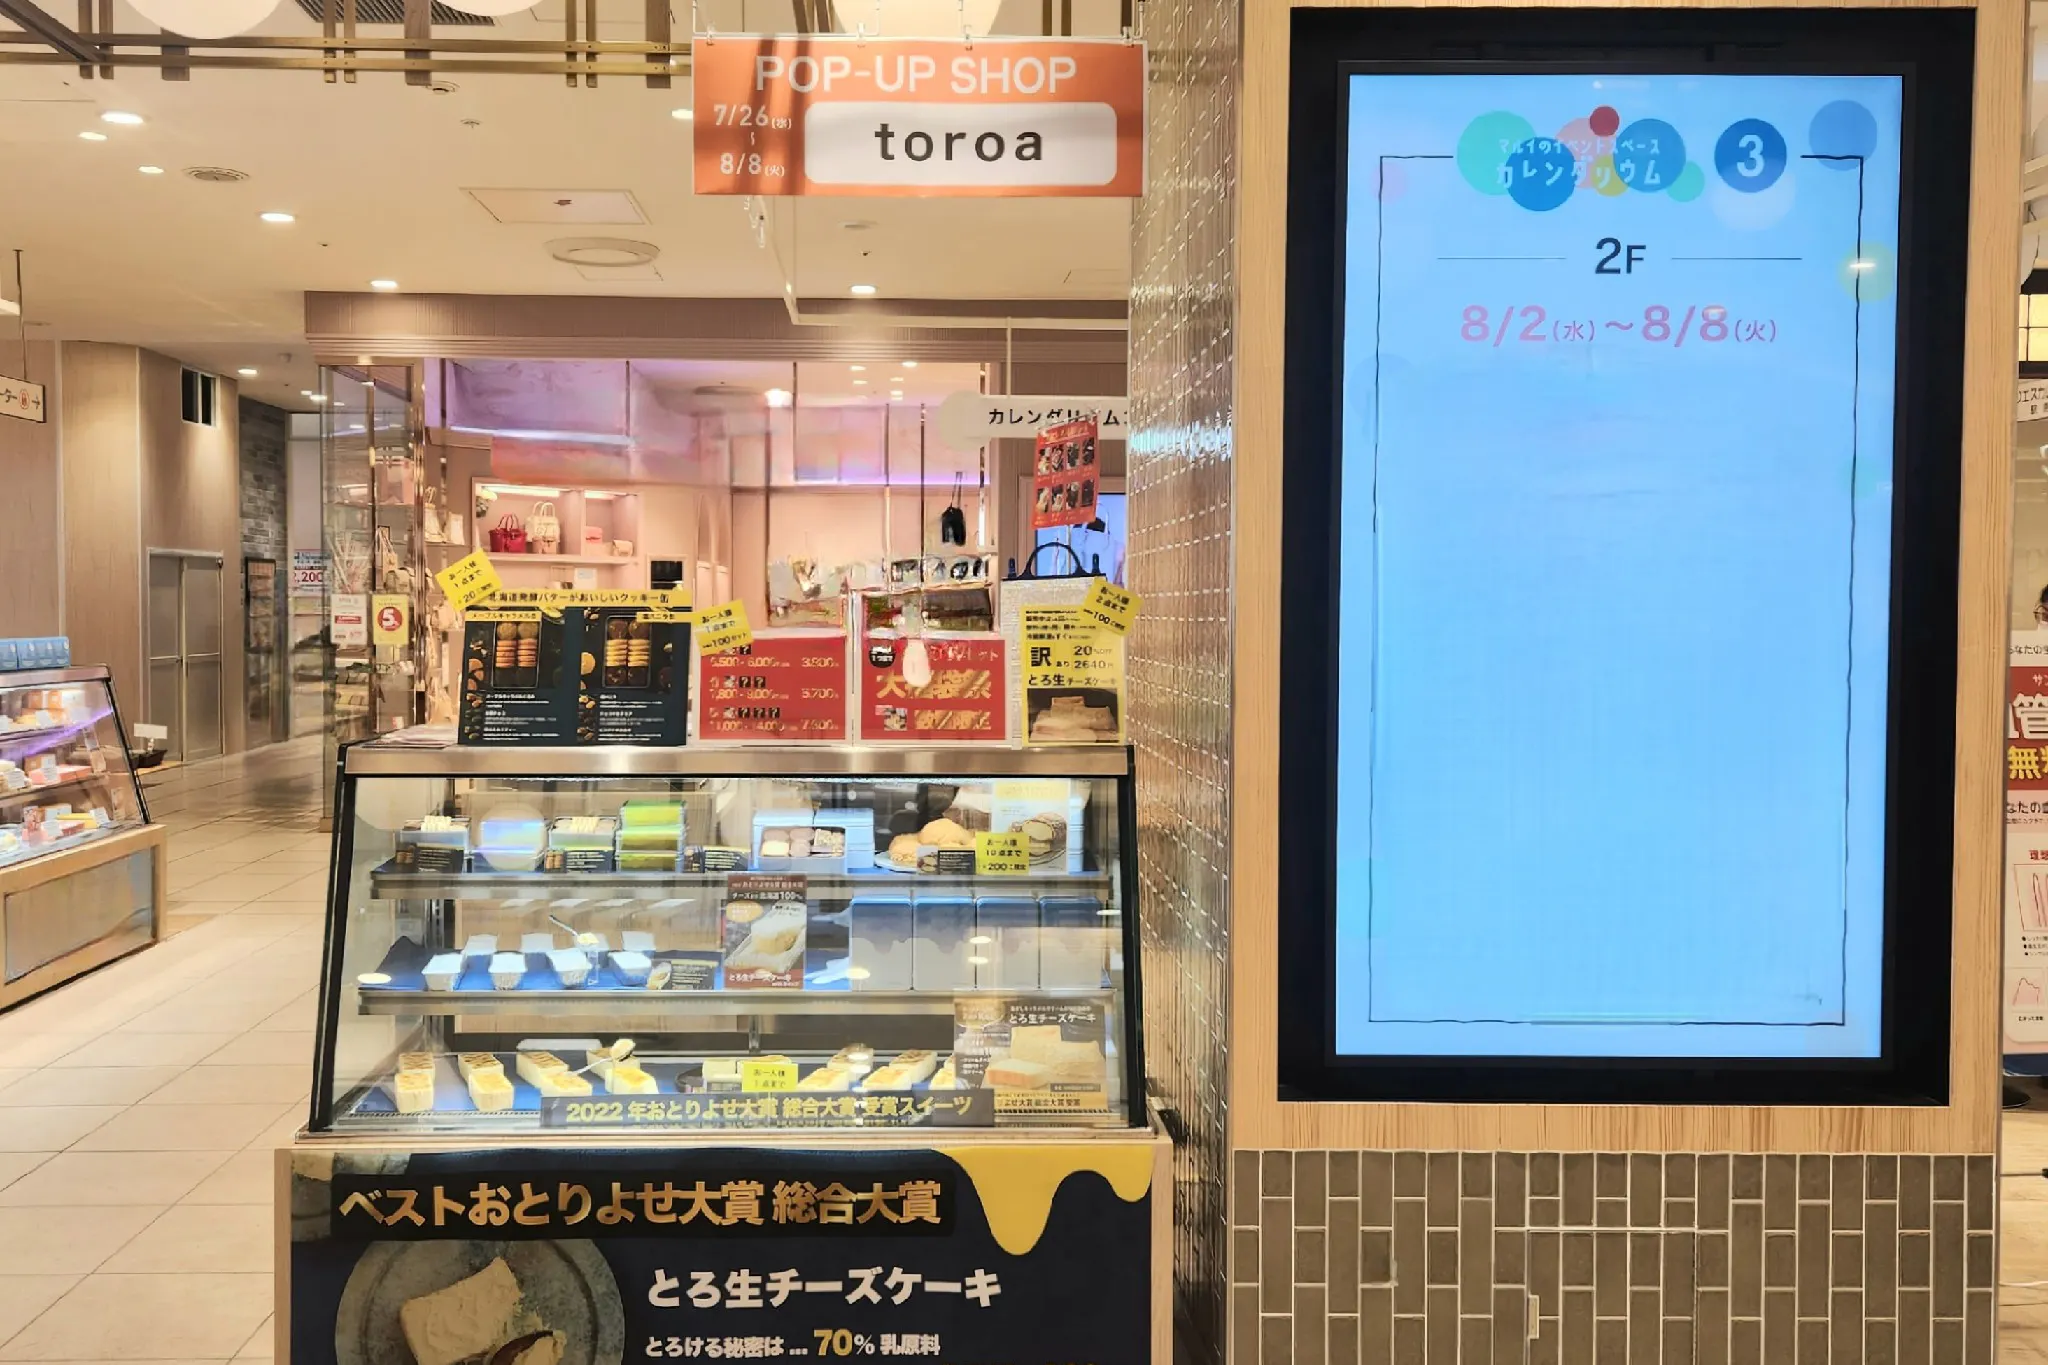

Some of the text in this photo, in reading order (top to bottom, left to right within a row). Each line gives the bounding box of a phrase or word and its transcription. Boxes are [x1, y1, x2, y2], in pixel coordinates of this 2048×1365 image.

[755, 56, 1077, 93] POP-UP SHOP
[875, 123, 1042, 161] toroa
[1499, 139, 1660, 155] マルイのイベントスペース
[1737, 134, 1764, 177] 3
[1497, 155, 1661, 189] カレンダリウム
[1595, 237, 1646, 274] 2F
[1009, 1013, 1096, 1024] とろ生チーズケーキ
[566, 1102, 623, 1123] 2022
[338, 1180, 941, 1227] ベストおとりよせ大賞 総合大賞
[646, 1268, 1002, 1309] とろ生チーズケーキ
[645, 1336, 785, 1358] とろける秘密は
[813, 1329, 876, 1356] 70%
